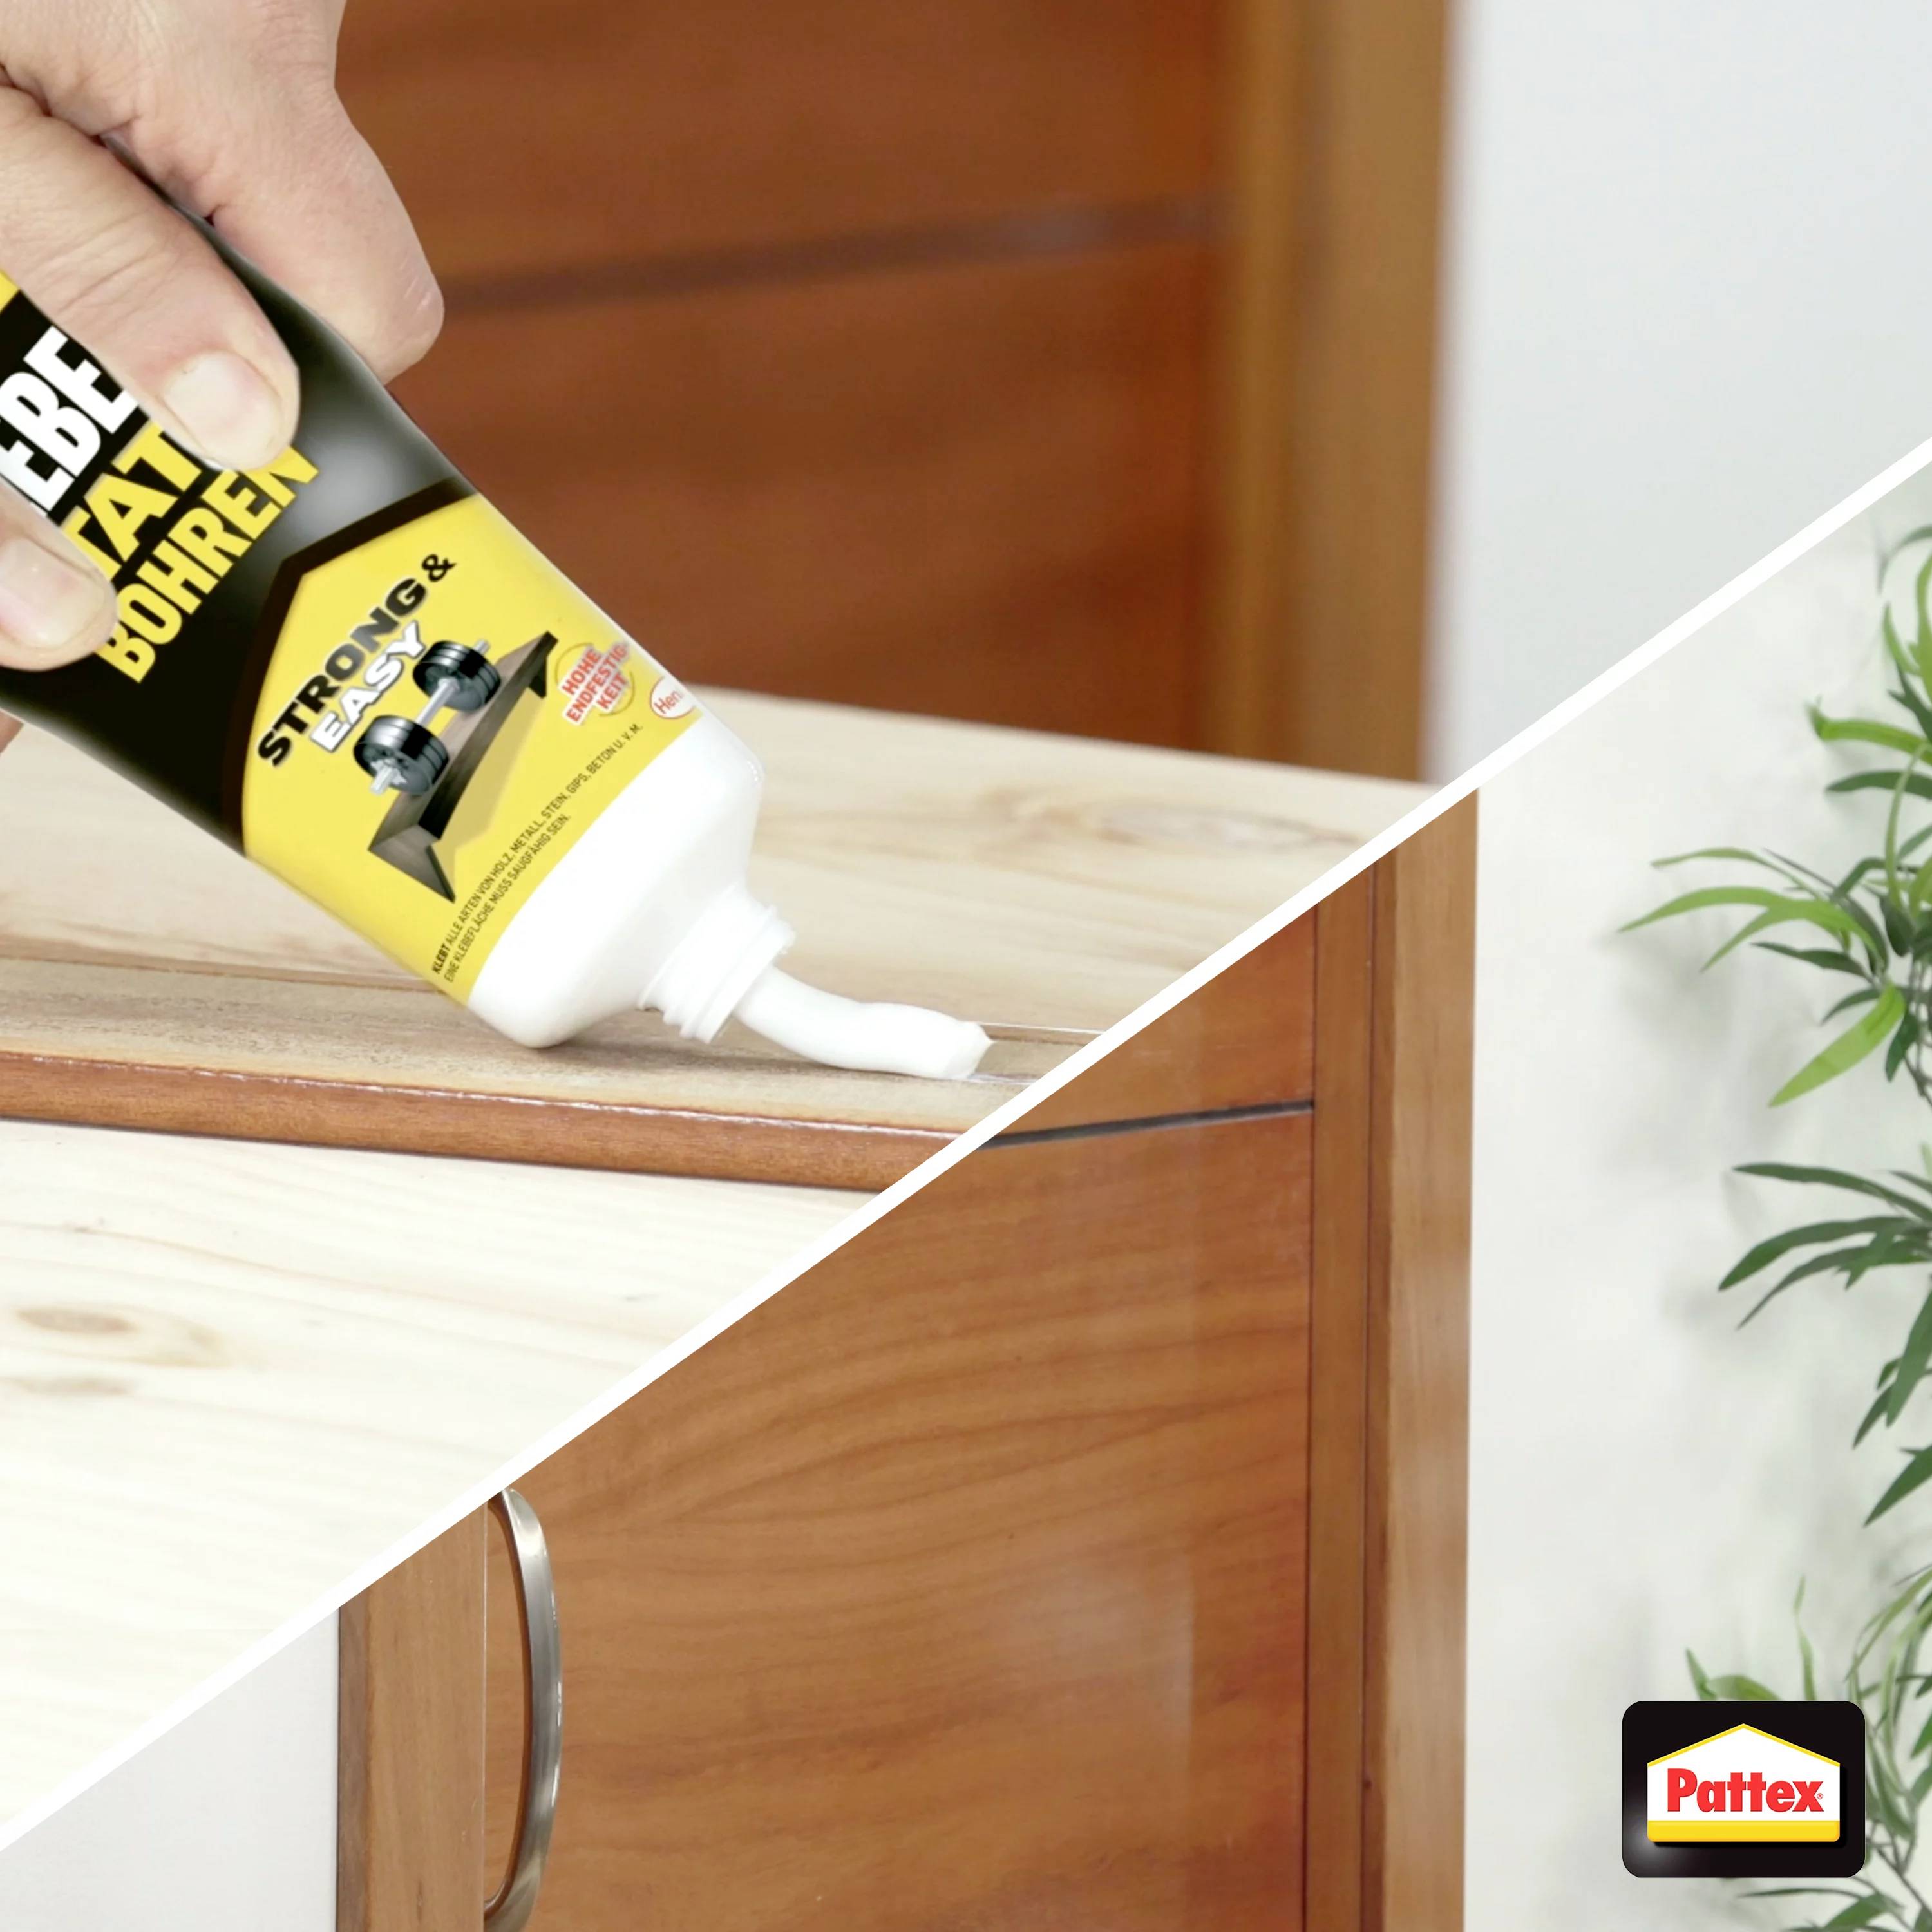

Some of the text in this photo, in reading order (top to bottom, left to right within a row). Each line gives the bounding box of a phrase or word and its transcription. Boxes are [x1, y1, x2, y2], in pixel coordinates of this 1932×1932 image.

[94, 446, 319, 683] BOHREN
[258, 554, 457, 766] STRONG &
[310, 621, 426, 753] EASY
[562, 648, 600, 695] HOHE
[596, 672, 628, 709] KEIT
[432, 943, 451, 974] KLEBT
[446, 922, 464, 946] ALLE
[458, 893, 482, 923] ARTEN
[477, 874, 495, 895] VON
[586, 746, 617, 774] BETON
[444, 961, 460, 982] EINE
[453, 902, 495, 961] KLEBEFLÄCHE
[489, 879, 513, 904] MUSS
[507, 833, 551, 880] SAUGFÄHIG
